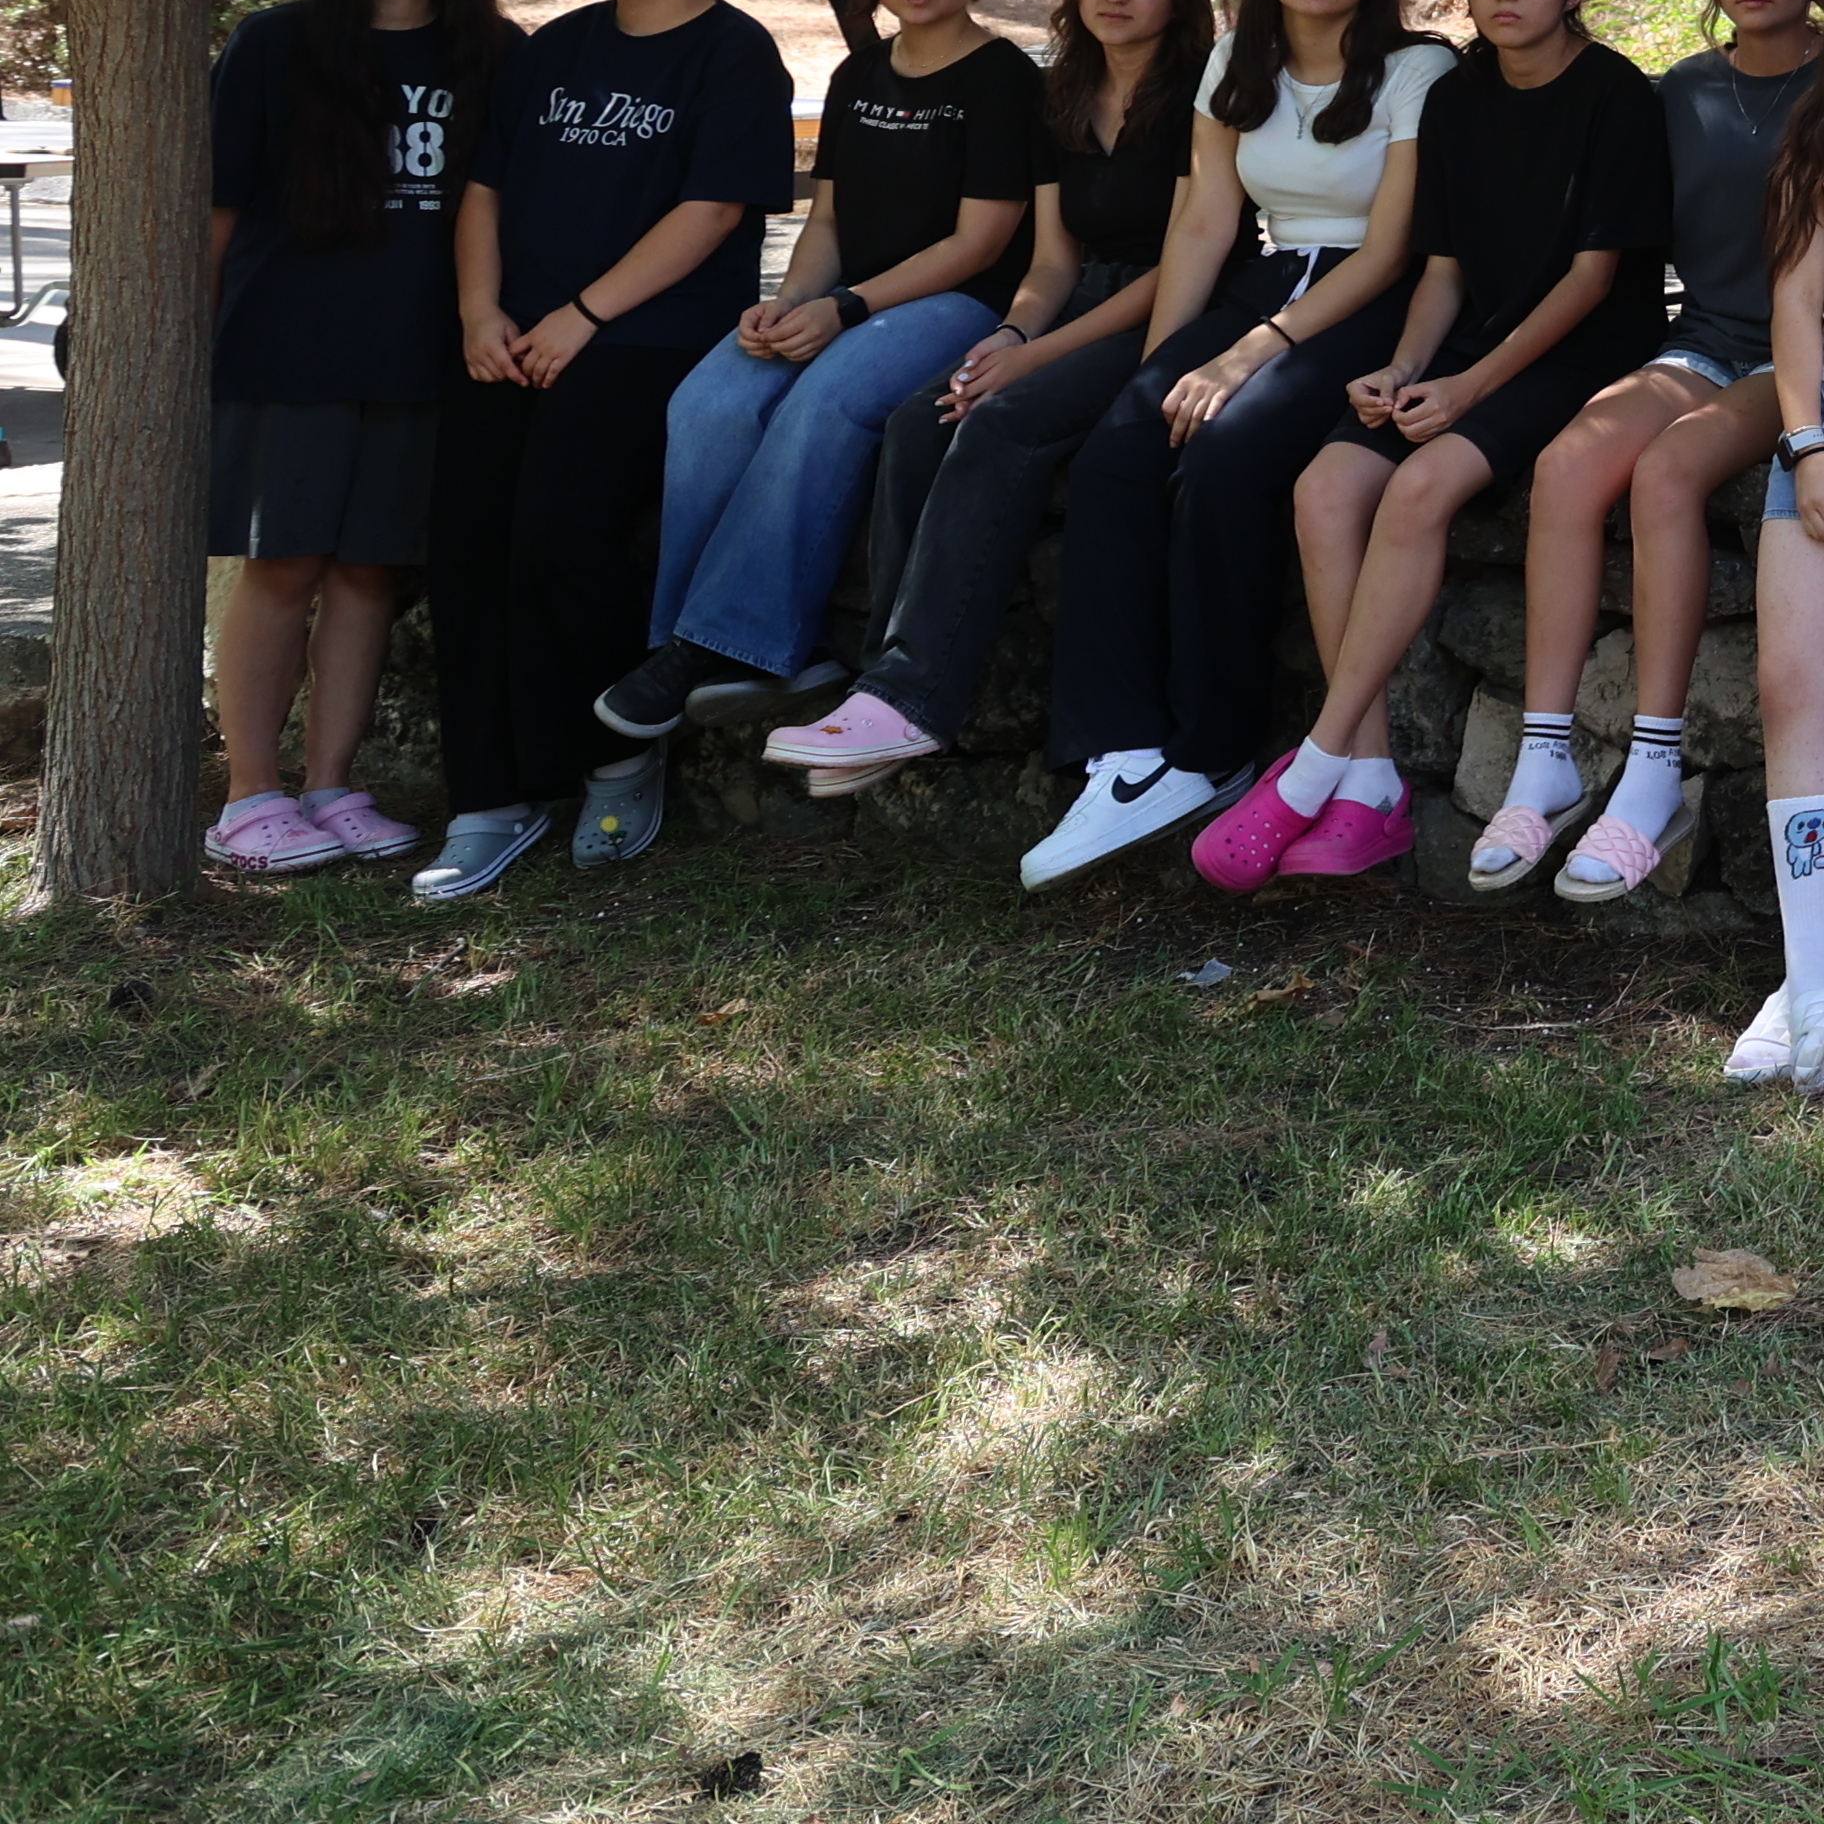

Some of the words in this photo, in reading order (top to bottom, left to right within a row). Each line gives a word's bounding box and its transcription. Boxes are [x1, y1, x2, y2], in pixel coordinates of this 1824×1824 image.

[539, 87, 586, 125] San
[591, 92, 675, 139] Diego
[559, 127, 600, 145] 1970
[601, 129, 627, 146] CA
